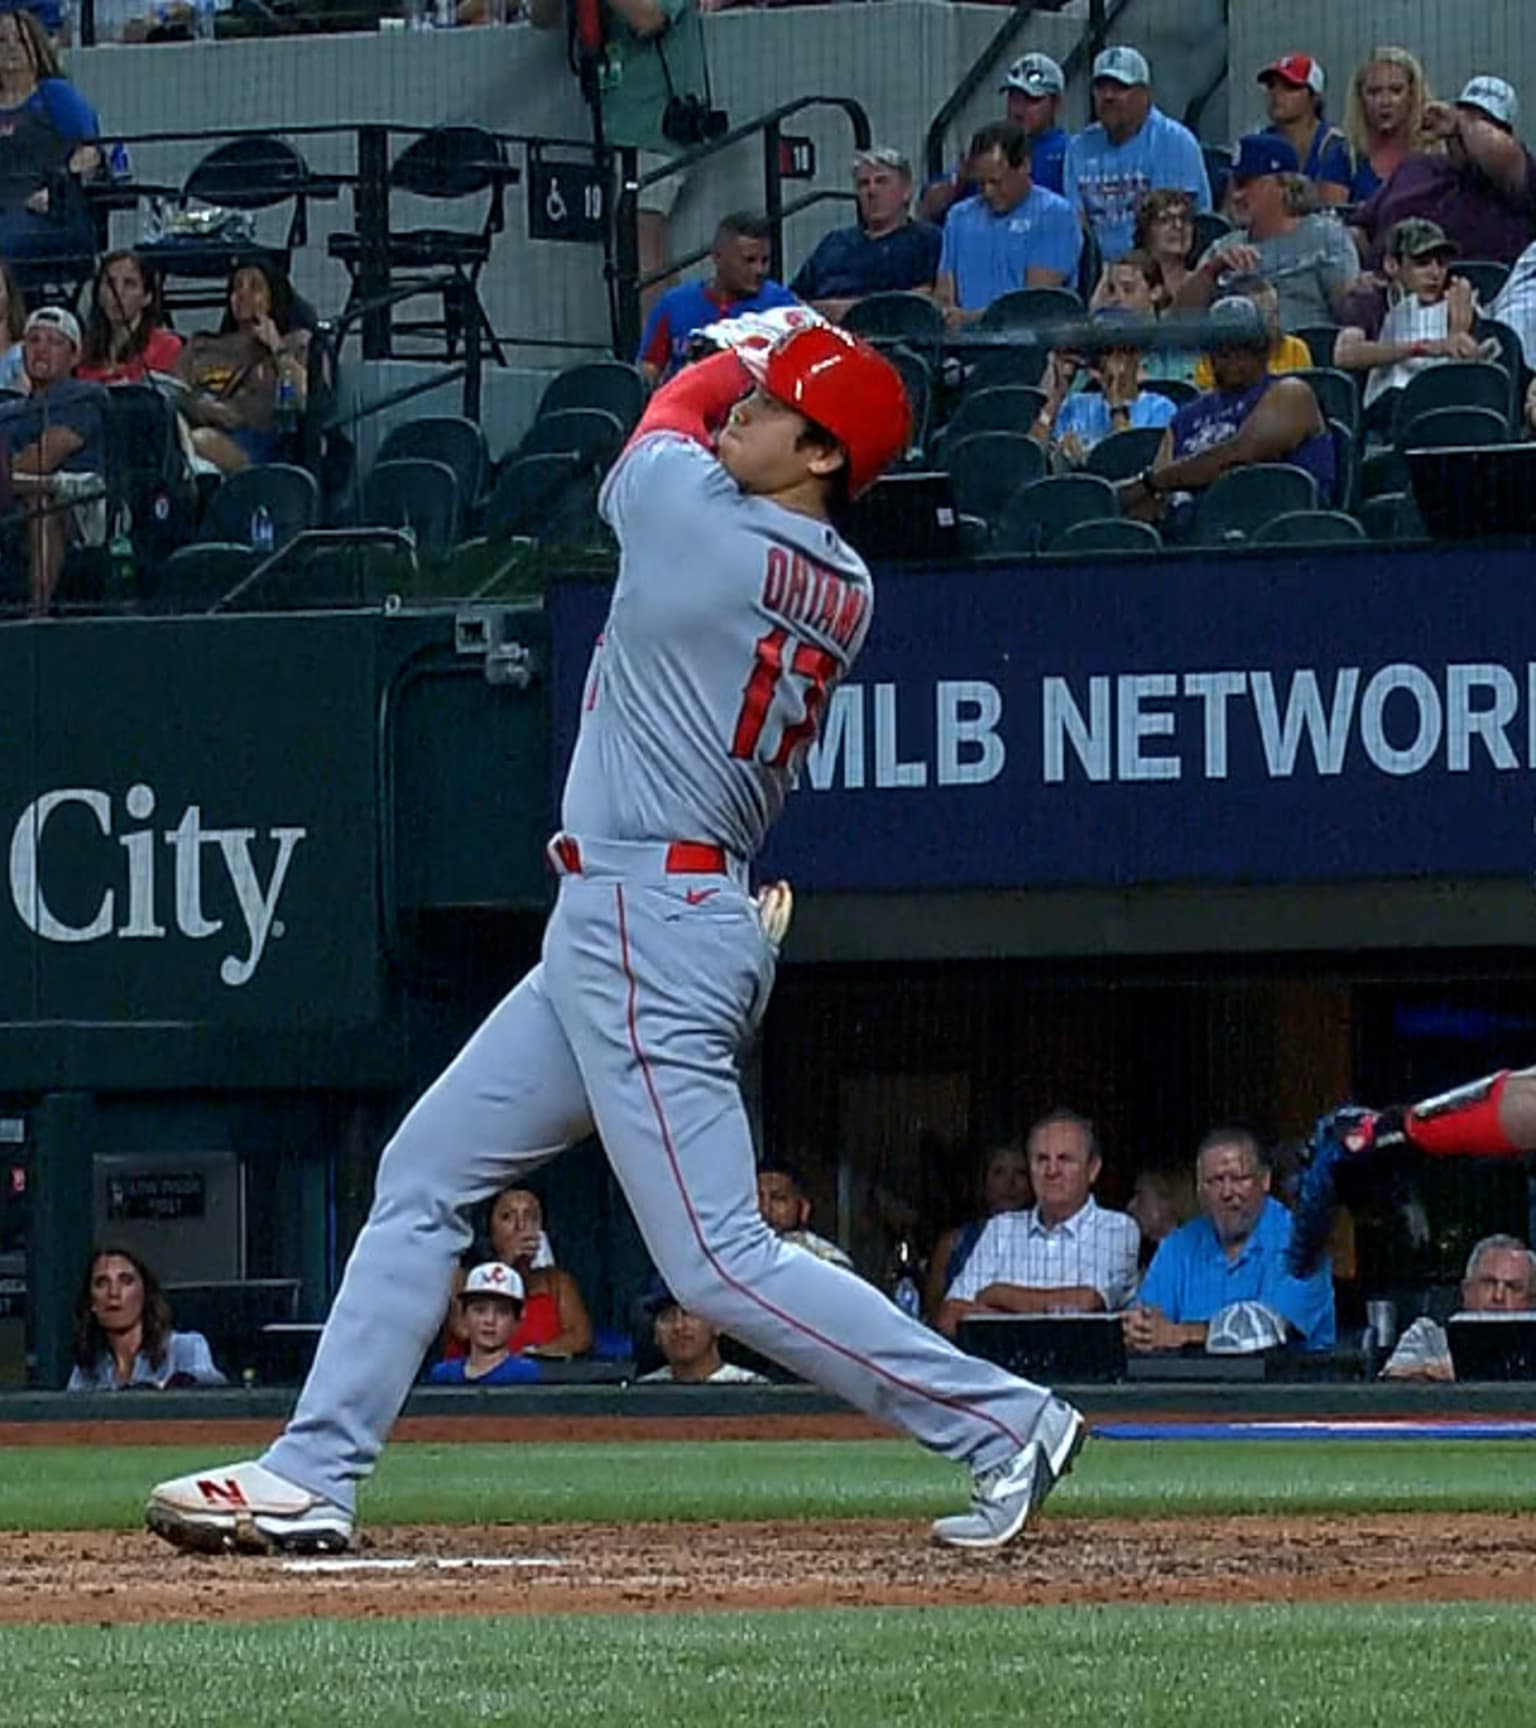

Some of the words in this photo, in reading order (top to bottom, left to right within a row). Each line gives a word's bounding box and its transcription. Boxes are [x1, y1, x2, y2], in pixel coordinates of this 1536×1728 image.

[762, 546, 867, 650] OHTAN
[729, 622, 836, 768] 17
[792, 681, 1007, 790] MLB
[1042, 662, 1536, 783] NETWOR
